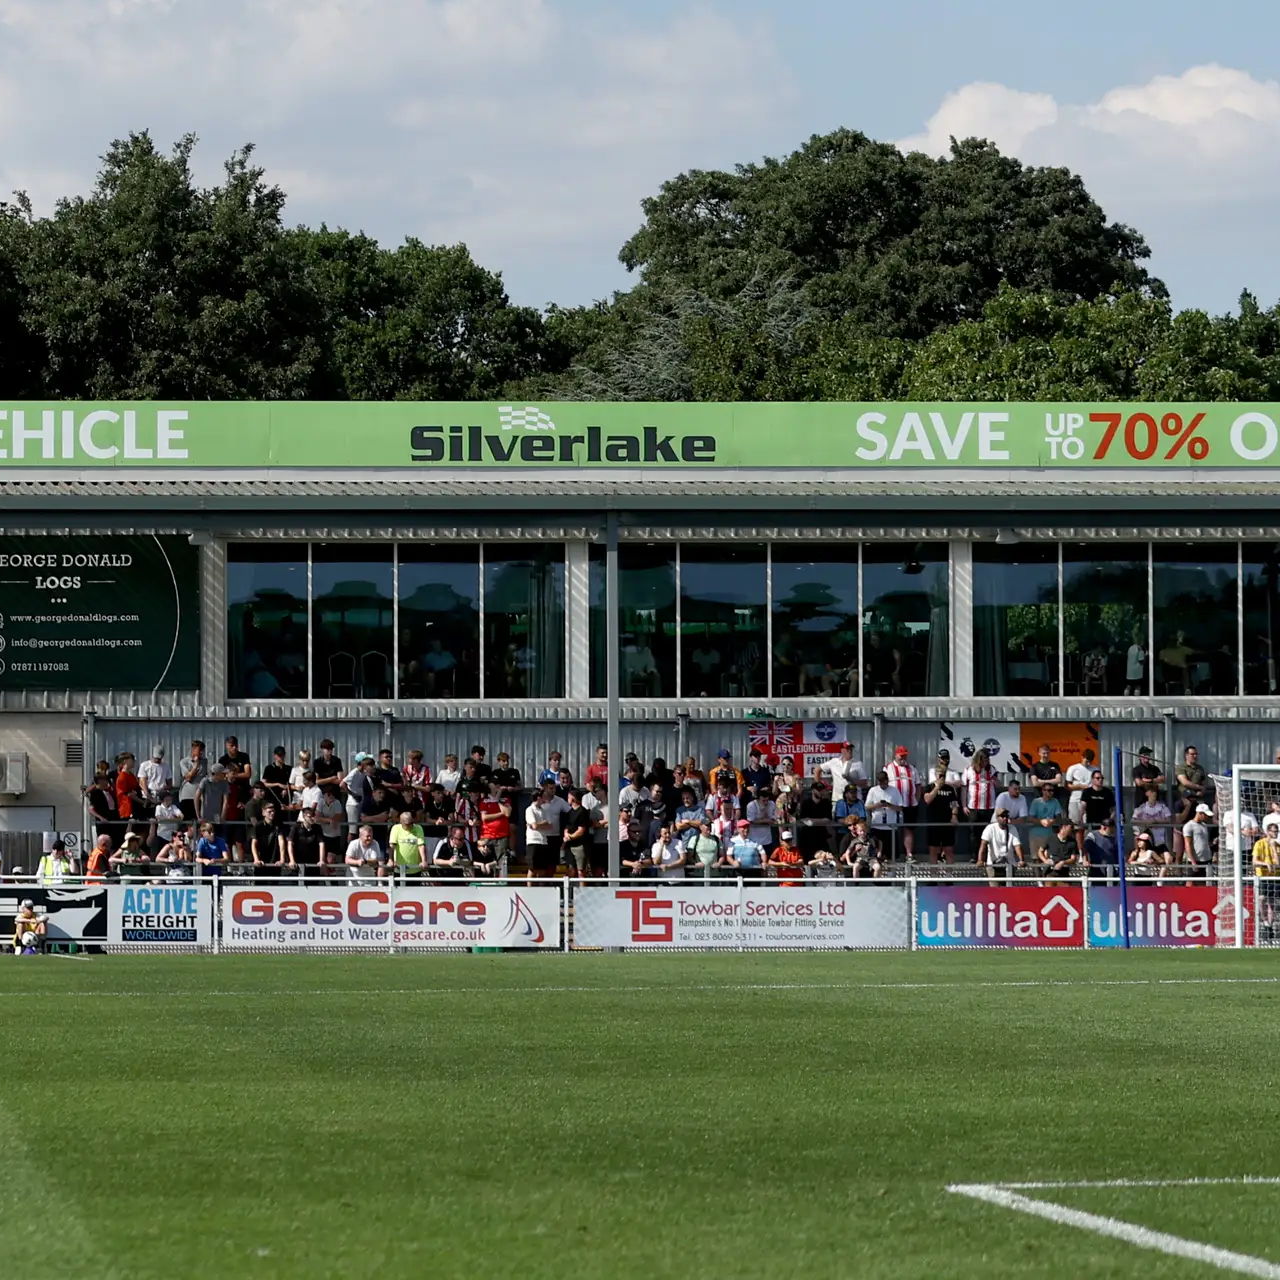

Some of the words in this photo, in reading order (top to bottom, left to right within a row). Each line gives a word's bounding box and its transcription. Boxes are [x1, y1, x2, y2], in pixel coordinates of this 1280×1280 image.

[1045, 413, 1084, 436] UP
[410, 426, 716, 462] Silverlake
[855, 412, 1010, 460] SAVE
[1089, 412, 1210, 460] 70%
[1044, 436, 1086, 459] TO
[62, 554, 132, 567] DONALD
[35, 576, 81, 589] LOGS
[10, 613, 140, 624] www.georgedonaldlogs.com
[11, 637, 143, 649] info@georgedonaldlogs.com
[771, 744, 814, 754] EASTLEIGH
[814, 743, 826, 753] FC
[122, 889, 197, 913] ACTIVE
[231, 891, 487, 925] GasCare
[678, 900, 740, 916] Towbar
[745, 900, 814, 916] Services
[819, 900, 845, 916] Ltd
[122, 915, 197, 928] FREIGHT
[615, 891, 673, 942] TS
[678, 918, 722, 928] Hampshire's
[724, 918, 739, 927] No.1
[741, 918, 766, 927] Mobile
[768, 918, 792, 927] Towbar
[794, 918, 817, 929] Fitting
[818, 918, 845, 927] Service
[921, 902, 1038, 938] utilita
[124, 929, 196, 941] WORLDWIDE
[232, 927, 285, 942] Heating
[290, 927, 315, 941] and
[320, 927, 344, 941] Hot
[348, 928, 389, 941] Water
[393, 927, 486, 943] gascare.co.uk
[694, 932, 710, 940] 023
[765, 932, 845, 940] towbarservices.com
